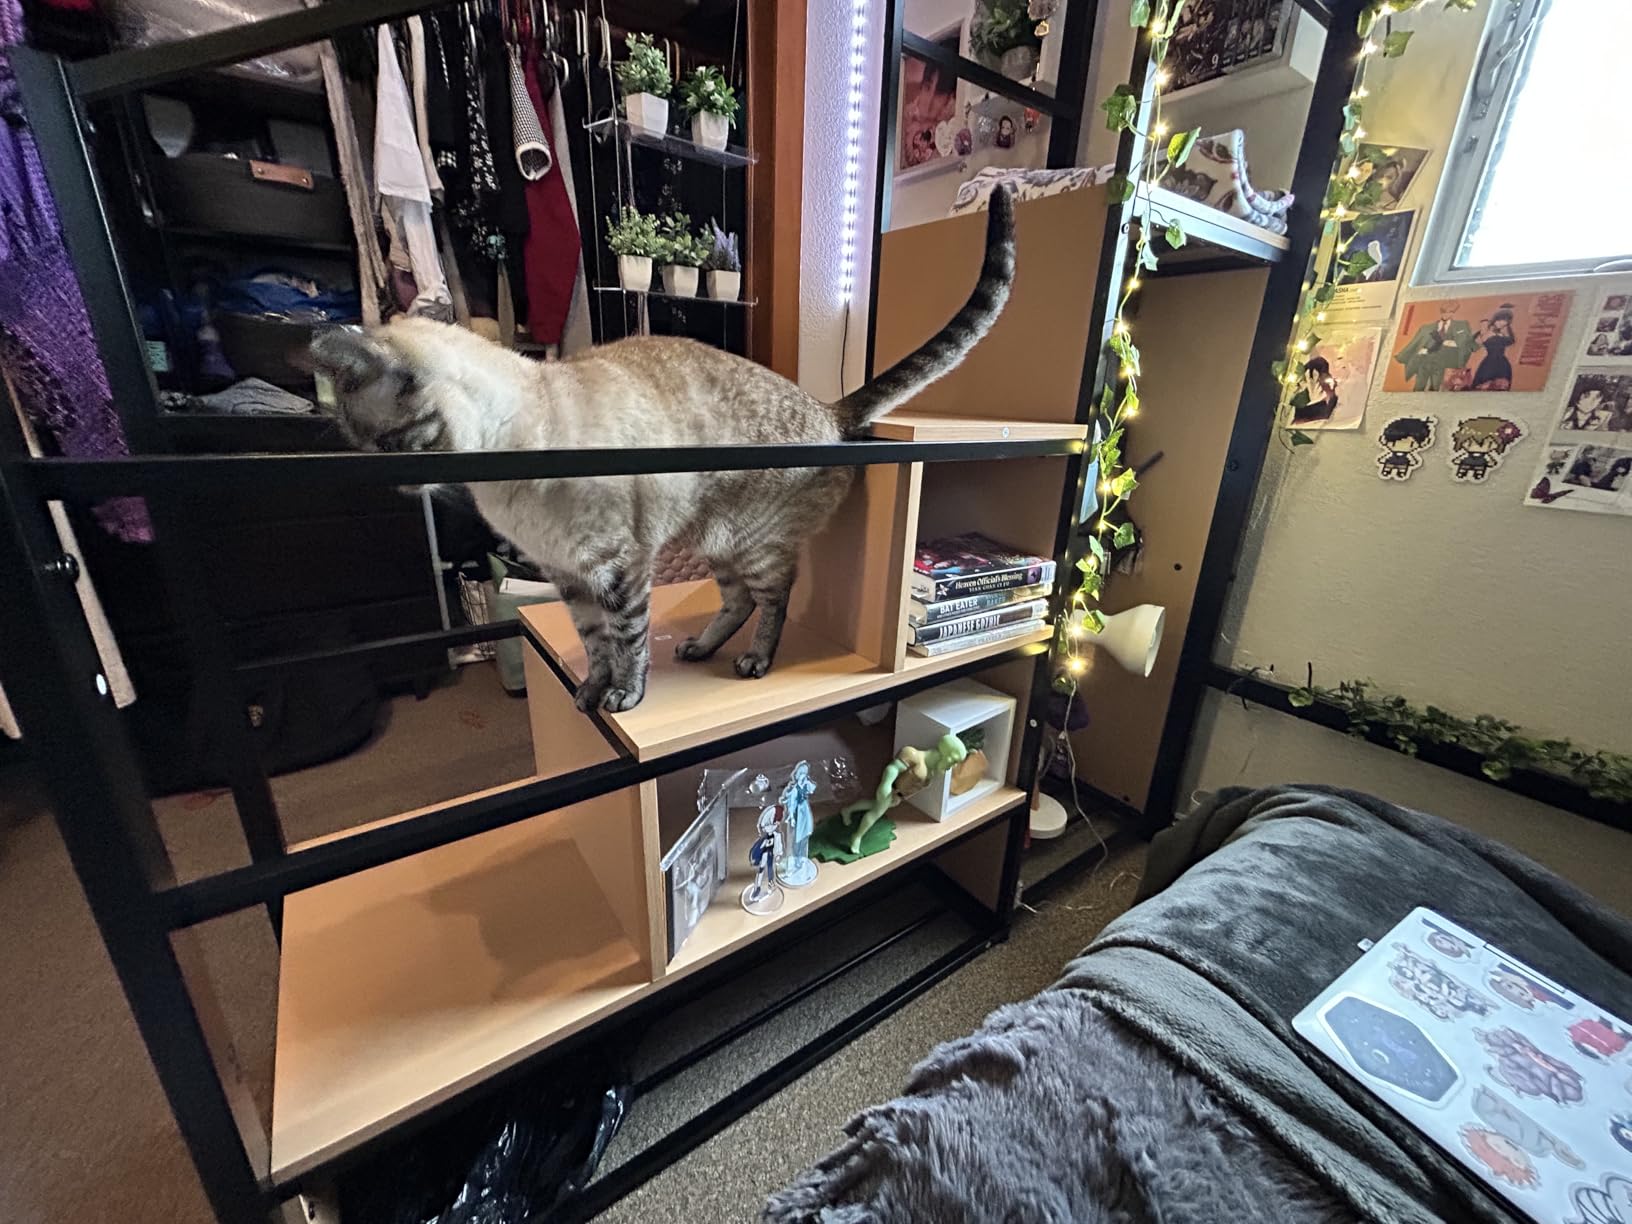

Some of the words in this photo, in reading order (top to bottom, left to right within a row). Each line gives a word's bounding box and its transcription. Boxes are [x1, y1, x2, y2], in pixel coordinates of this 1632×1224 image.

[955, 579, 977, 590] Heaven
[976, 574, 1001, 586] Official's
[1001, 572, 1023, 583] Blessing
[940, 604, 955, 614] BAT
[955, 599, 978, 611] EATER
[939, 620, 975, 639] JAPANESE
[975, 614, 1001, 631] GOTHIC
